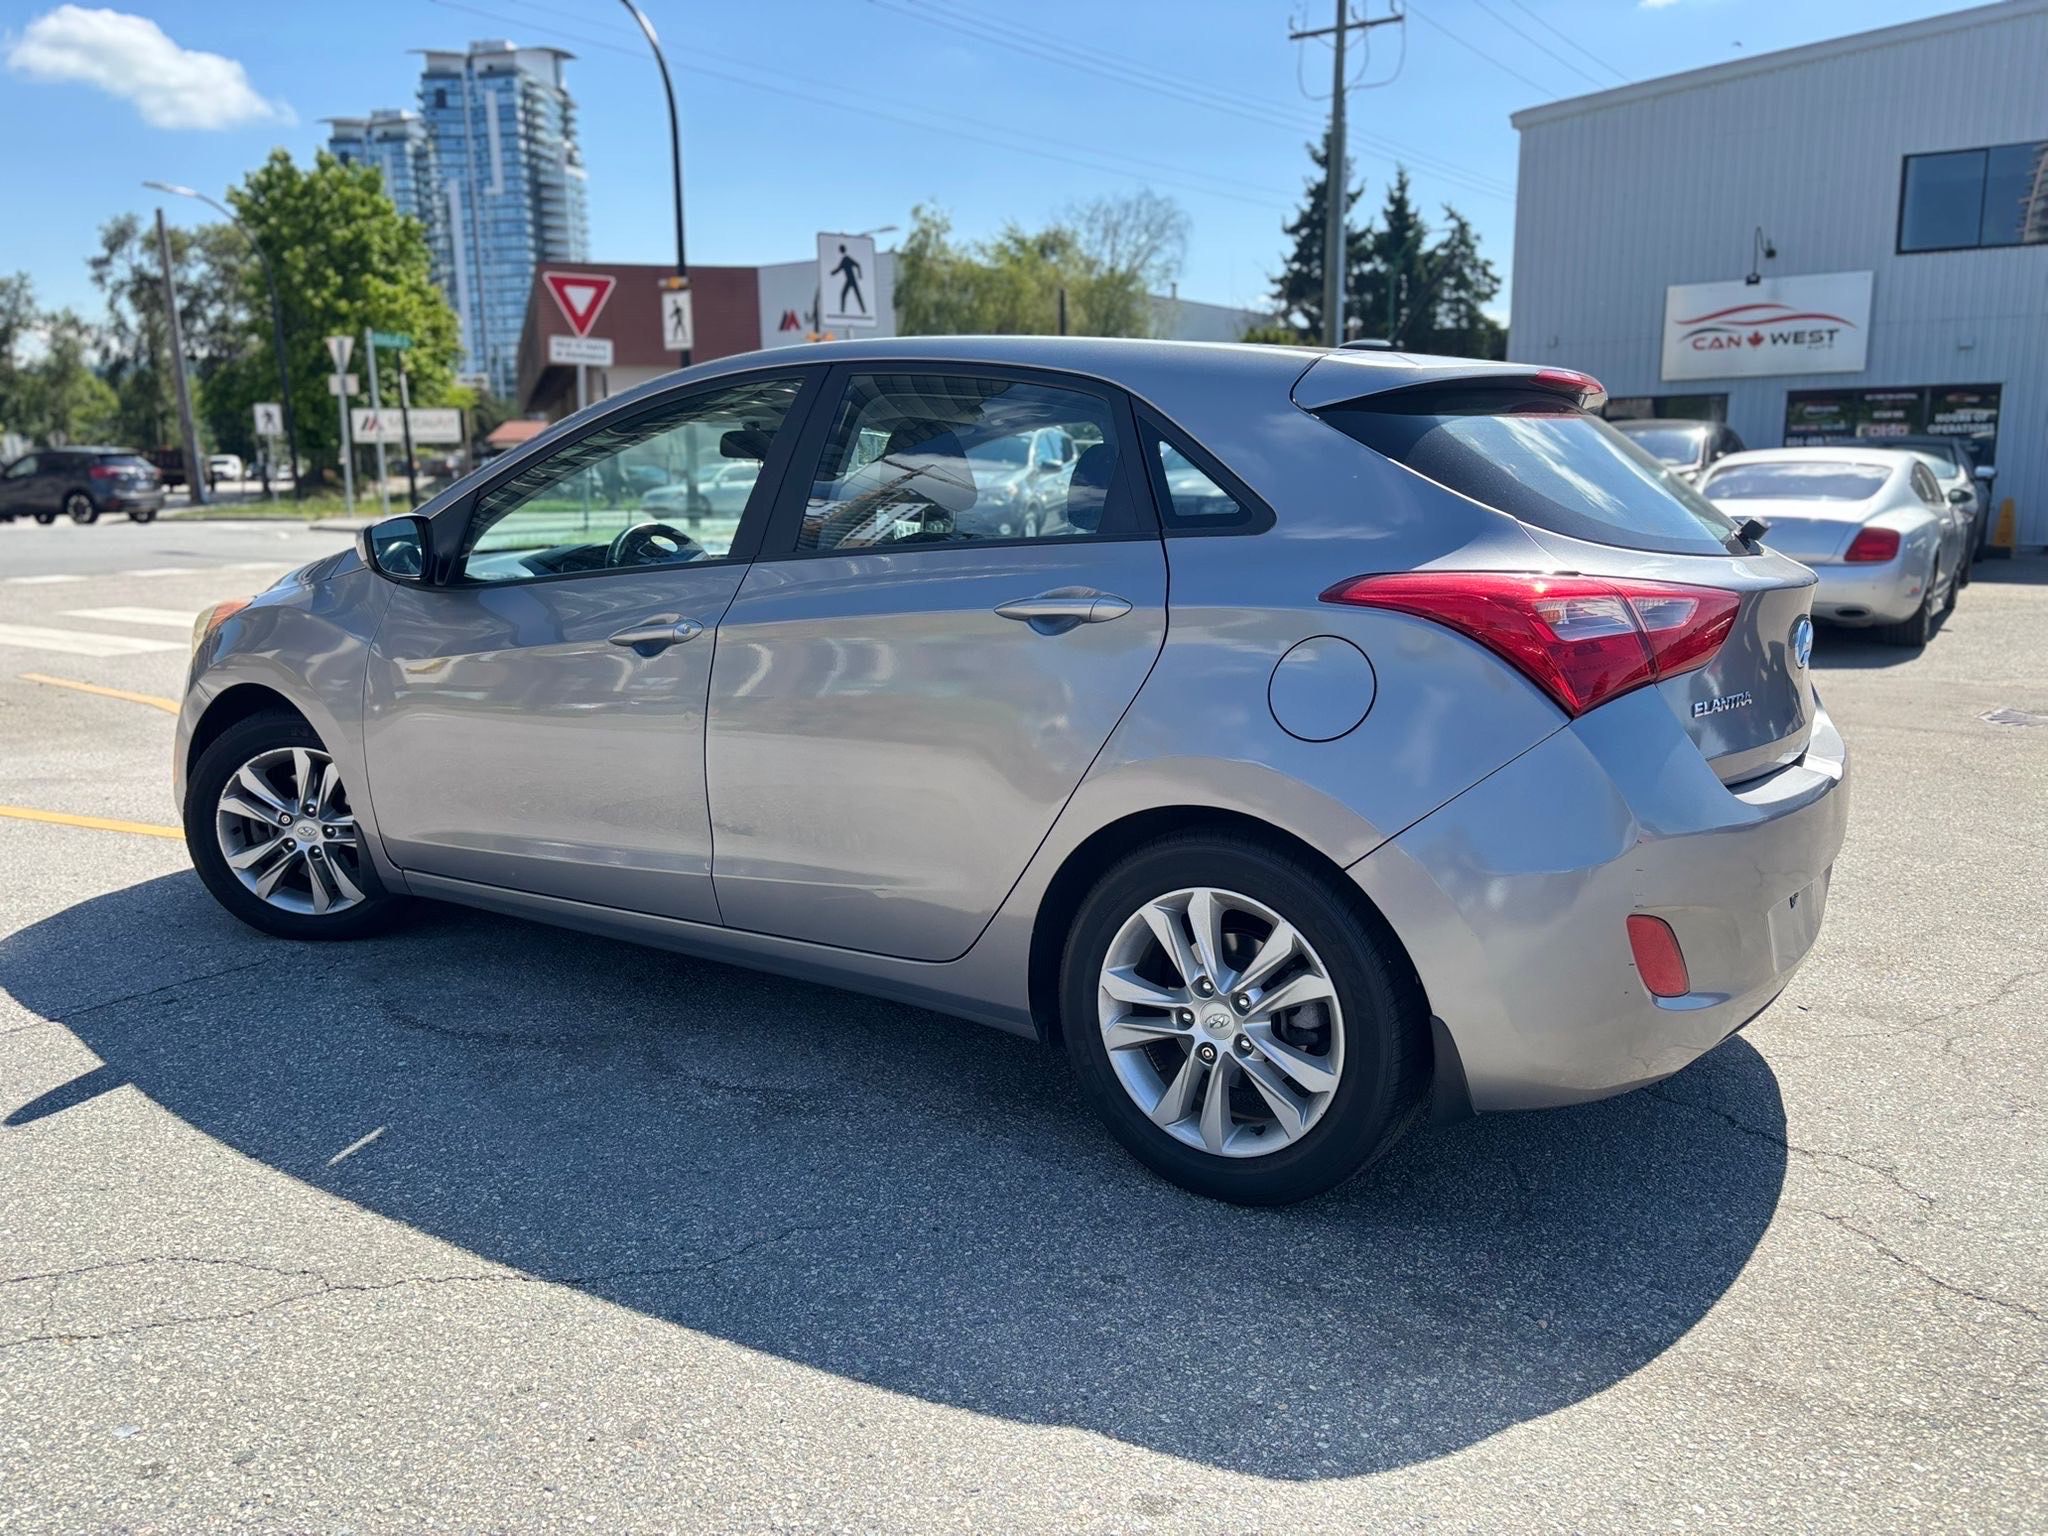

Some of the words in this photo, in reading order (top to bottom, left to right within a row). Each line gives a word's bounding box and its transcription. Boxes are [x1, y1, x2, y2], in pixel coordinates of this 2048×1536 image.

[1692, 335, 1742, 351] CAN
[1771, 328, 1840, 346] WEST
[1934, 412, 1971, 423] HOURS
[1973, 412, 1989, 423] OF
[1926, 423, 1995, 435] OPERATIONS
[1692, 691, 1753, 718] ELANTRA
